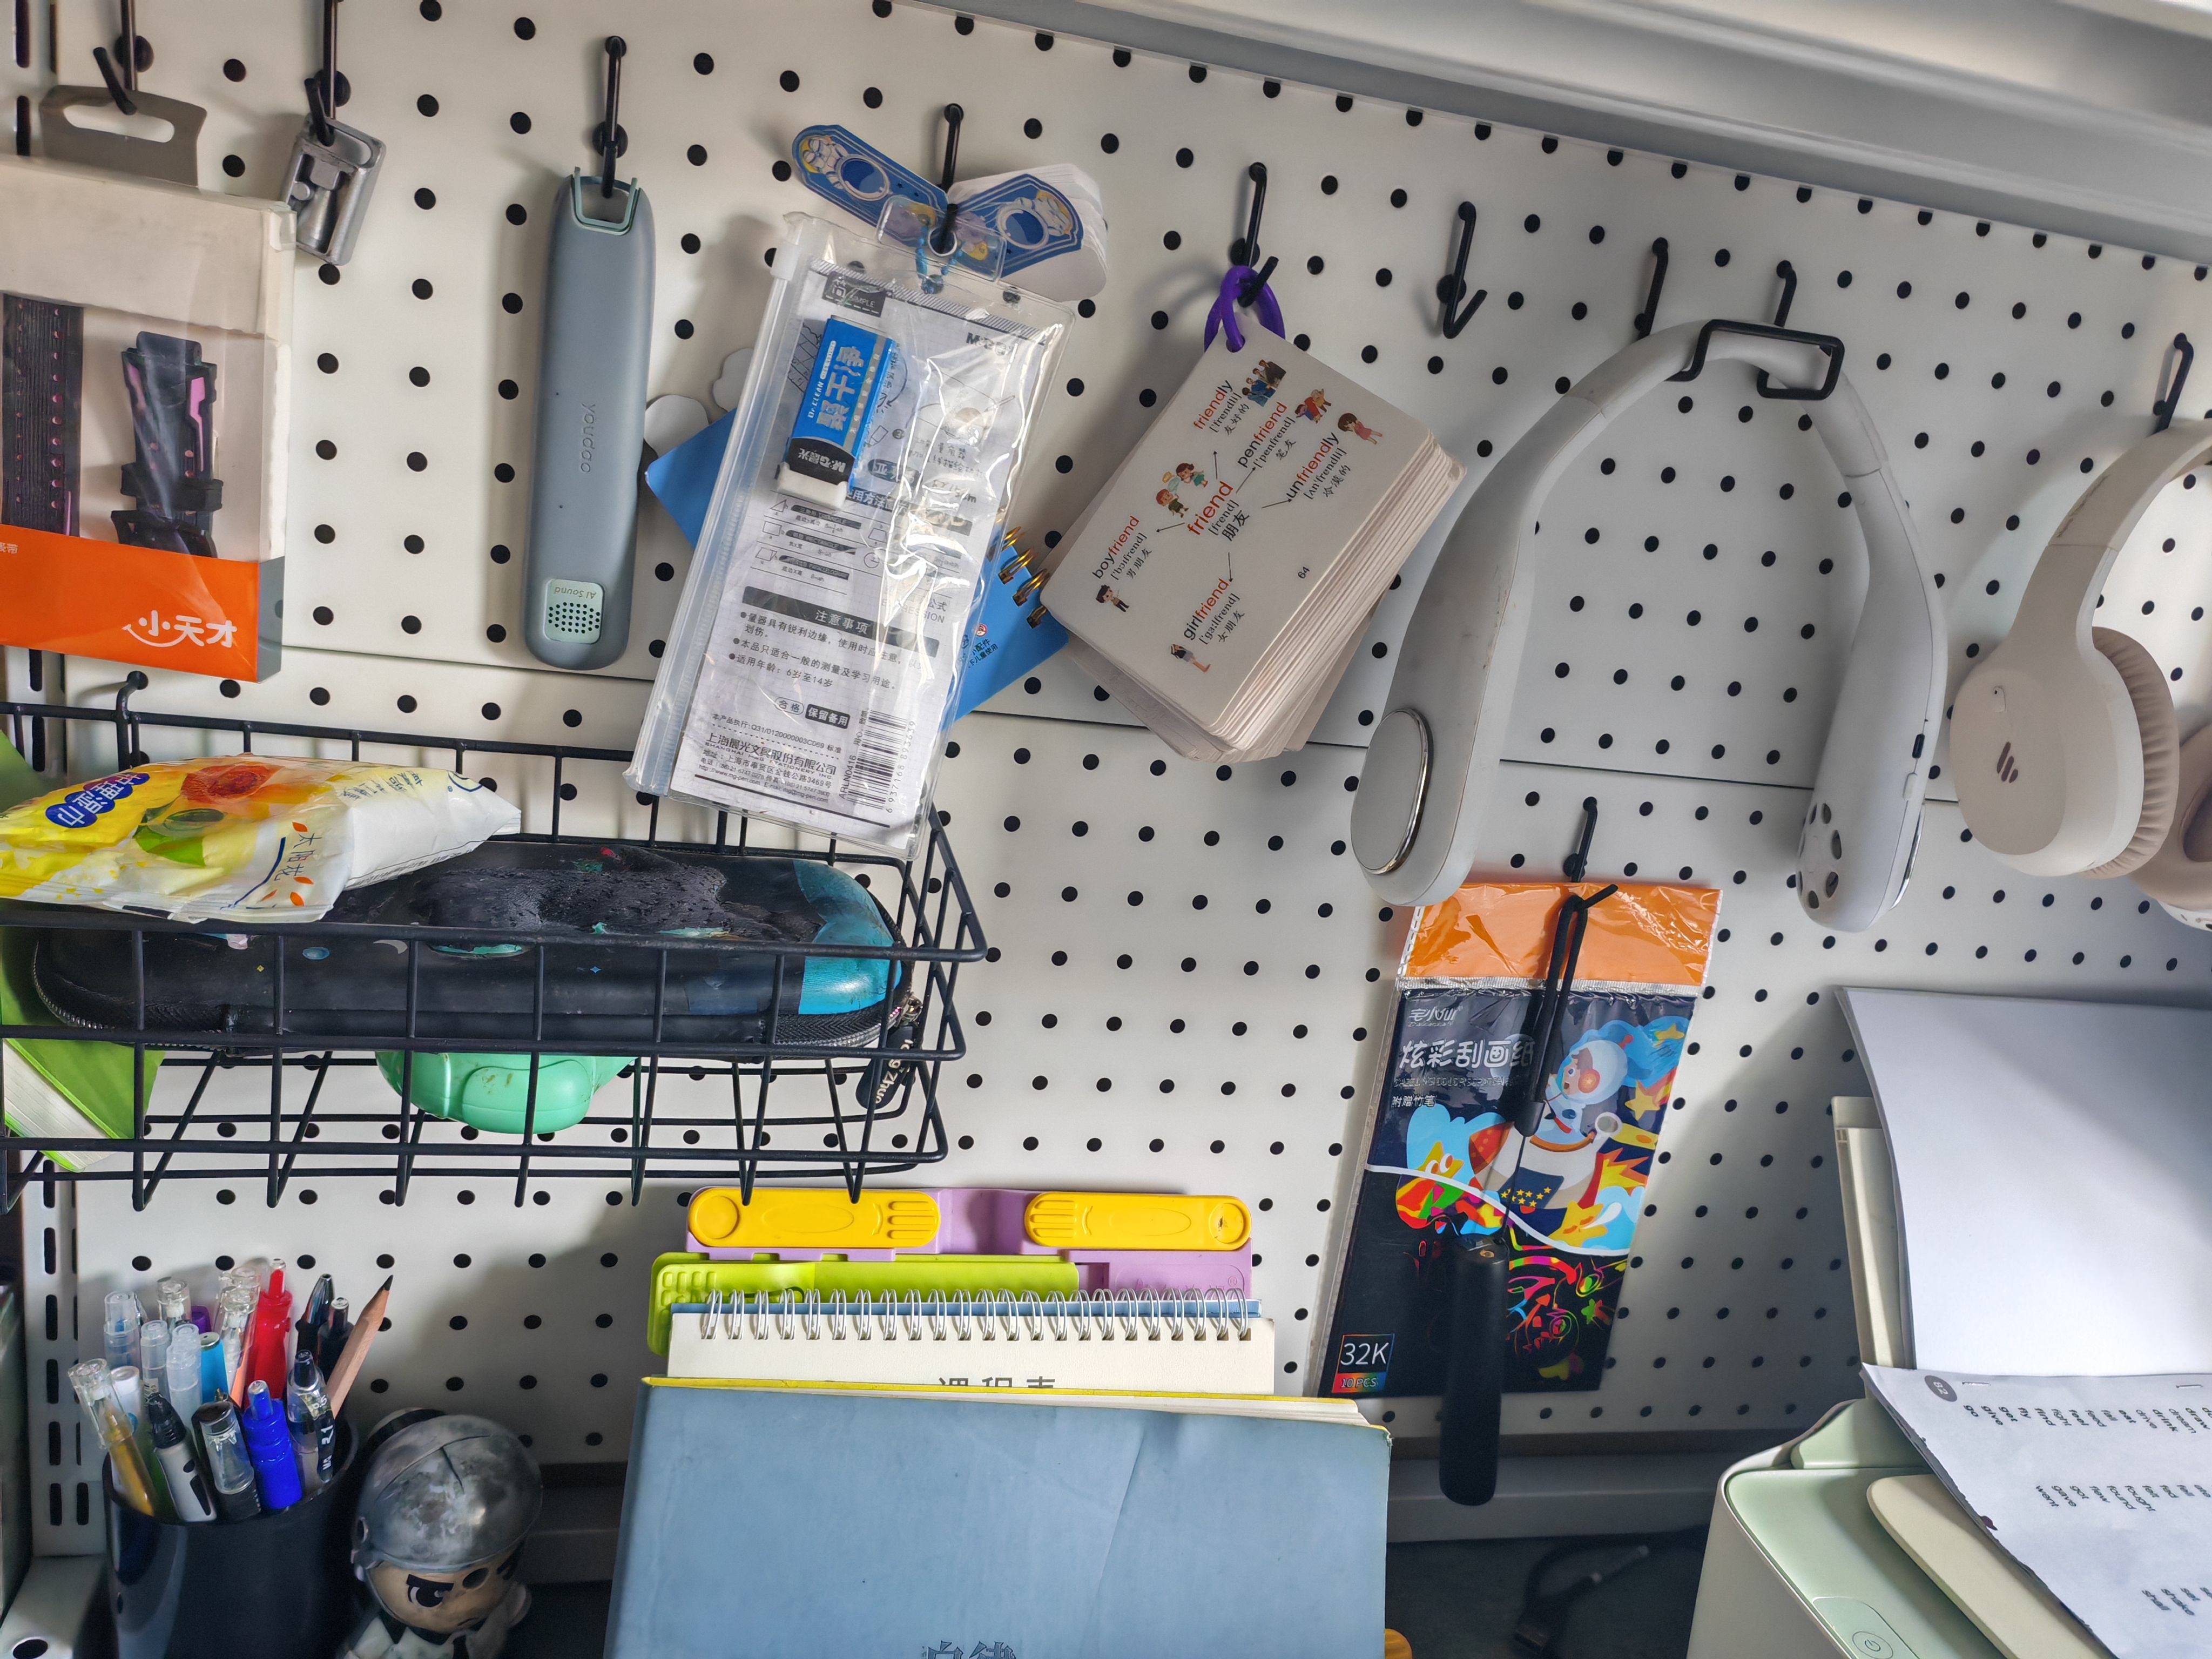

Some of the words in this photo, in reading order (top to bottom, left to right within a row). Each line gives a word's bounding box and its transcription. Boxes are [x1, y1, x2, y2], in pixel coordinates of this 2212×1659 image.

[1193, 380, 1233, 430] friendly
[1224, 402, 1250, 436] 友好的
[1237, 401, 1288, 469] penfriend
[1275, 439, 1297, 461] 笔友
[1286, 431, 1340, 500] unfriendly
[1323, 464, 1351, 498] 冷漠的
[1187, 481, 1234, 536] friend
[1221, 510, 1250, 542] 朋友
[1091, 515, 1140, 579] boyfriend
[1125, 548, 1152, 579] 男朋友
[1297, 565, 1311, 580] 64
[554, 586, 584, 597] Sound
[1183, 578, 1230, 641] girlfriend
[136, 609, 238, 648] 小天才
[814, 609, 869, 635] 注意事项
[1218, 609, 1246, 643] 女朋友
[777, 699, 801, 713] 合格
[806, 706, 849, 727] 保留备用
[60, 771, 146, 828] 护理湿巾
[1400, 1036, 1535, 1070] 炫彩刮画纸
[1392, 1093, 1435, 1109] 附赠竹笔
[1340, 1343, 1389, 1365] 32K
[1356, 1378, 1377, 1387] PCS
[1964, 1405, 1979, 1417] go
[1981, 1405, 2004, 1426] give
[1999, 1406, 2018, 1422] get
[2018, 1407, 2032, 1419] fly
[2034, 1407, 2056, 1426] find
[2068, 1409, 2089, 1426] feel
[2085, 1409, 2107, 1427] feed
[2118, 1409, 2136, 1424] eat
[2136, 1409, 2157, 1429] drive
[2152, 1409, 2179, 1432] drink
[2168, 1408, 2197, 1433] dream
[2185, 1407, 2211, 1429] draw
[2035, 1485, 2060, 1508] went
[2052, 1485, 2077, 1507] gave
[2069, 1485, 2089, 1500] got
[2089, 1485, 2111, 1503] flew
[2106, 1485, 2137, 1509] found
[2125, 1485, 2156, 1512] fought
[2160, 1485, 2180, 1498] fed
[2194, 1485, 2211, 1498] ate
[2141, 1589, 2171, 1610] shall
[2160, 1588, 2196, 1616] shake
[2180, 1588, 2201, 1601] set
